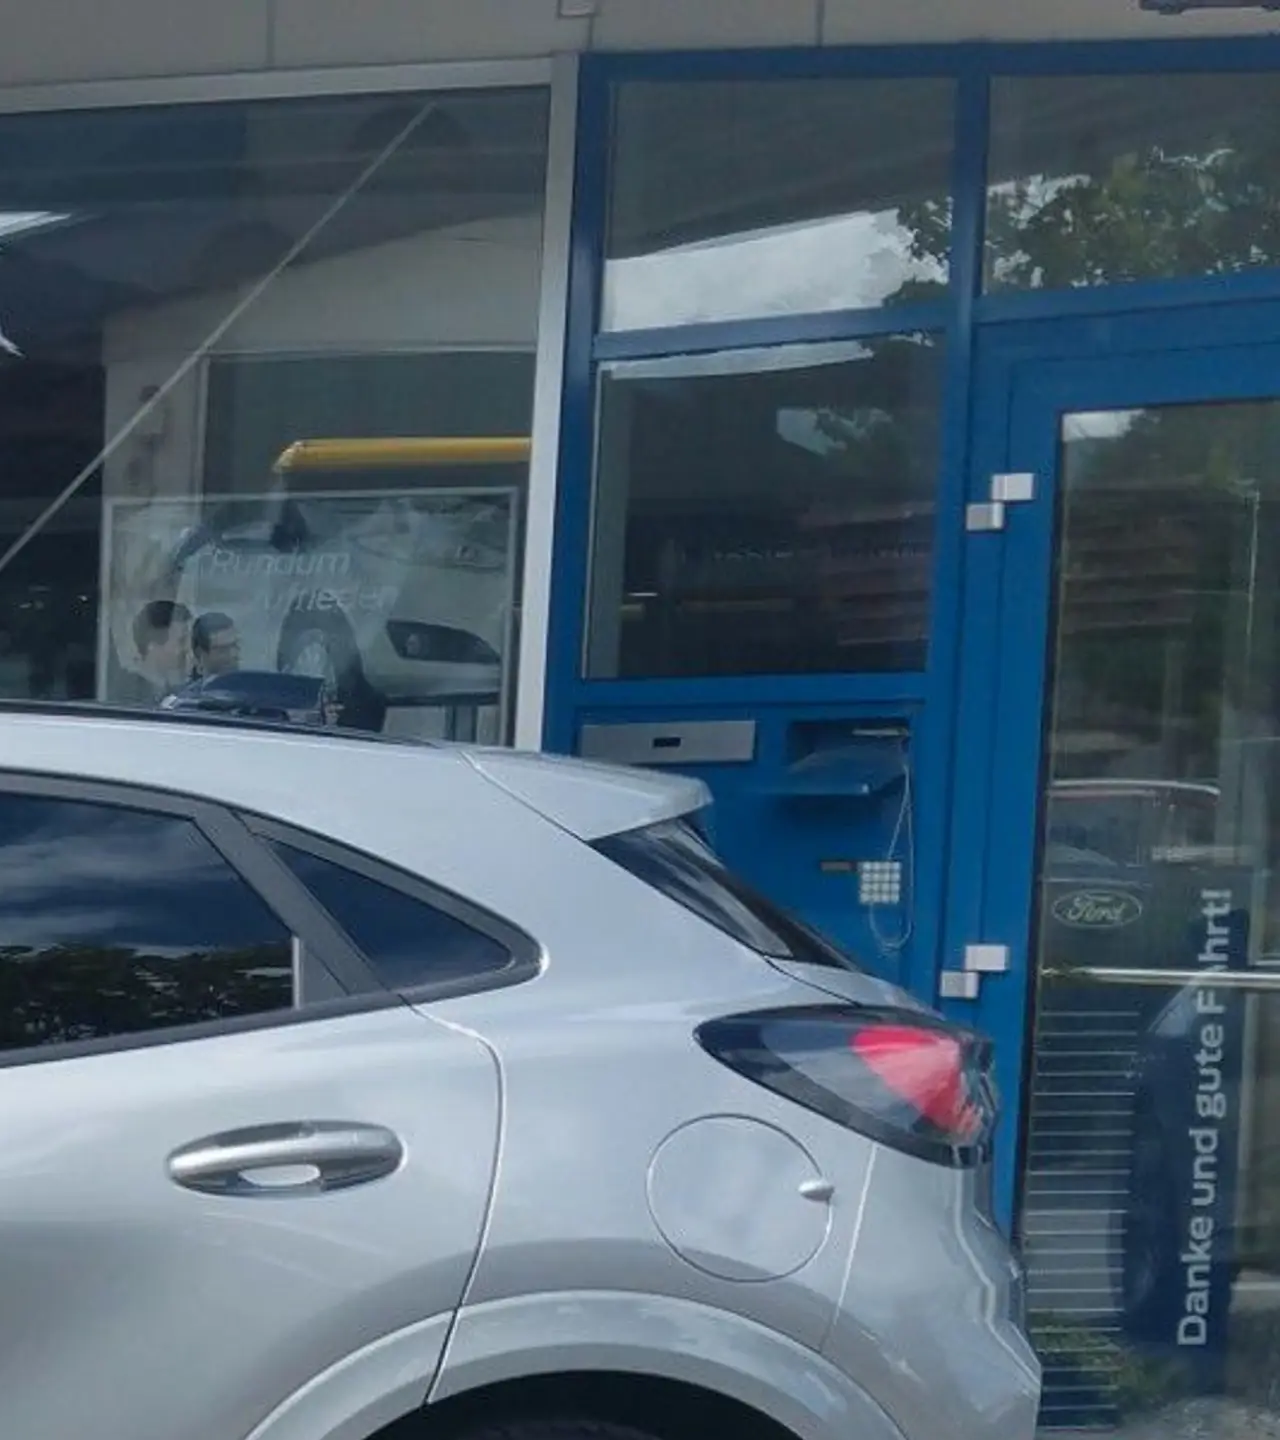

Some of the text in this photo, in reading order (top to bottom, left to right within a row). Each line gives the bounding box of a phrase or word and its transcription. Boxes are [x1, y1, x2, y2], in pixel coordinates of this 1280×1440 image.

[1061, 894, 1127, 922] Ford
[1177, 888, 1233, 1345] Danke und gute Fhrt!
